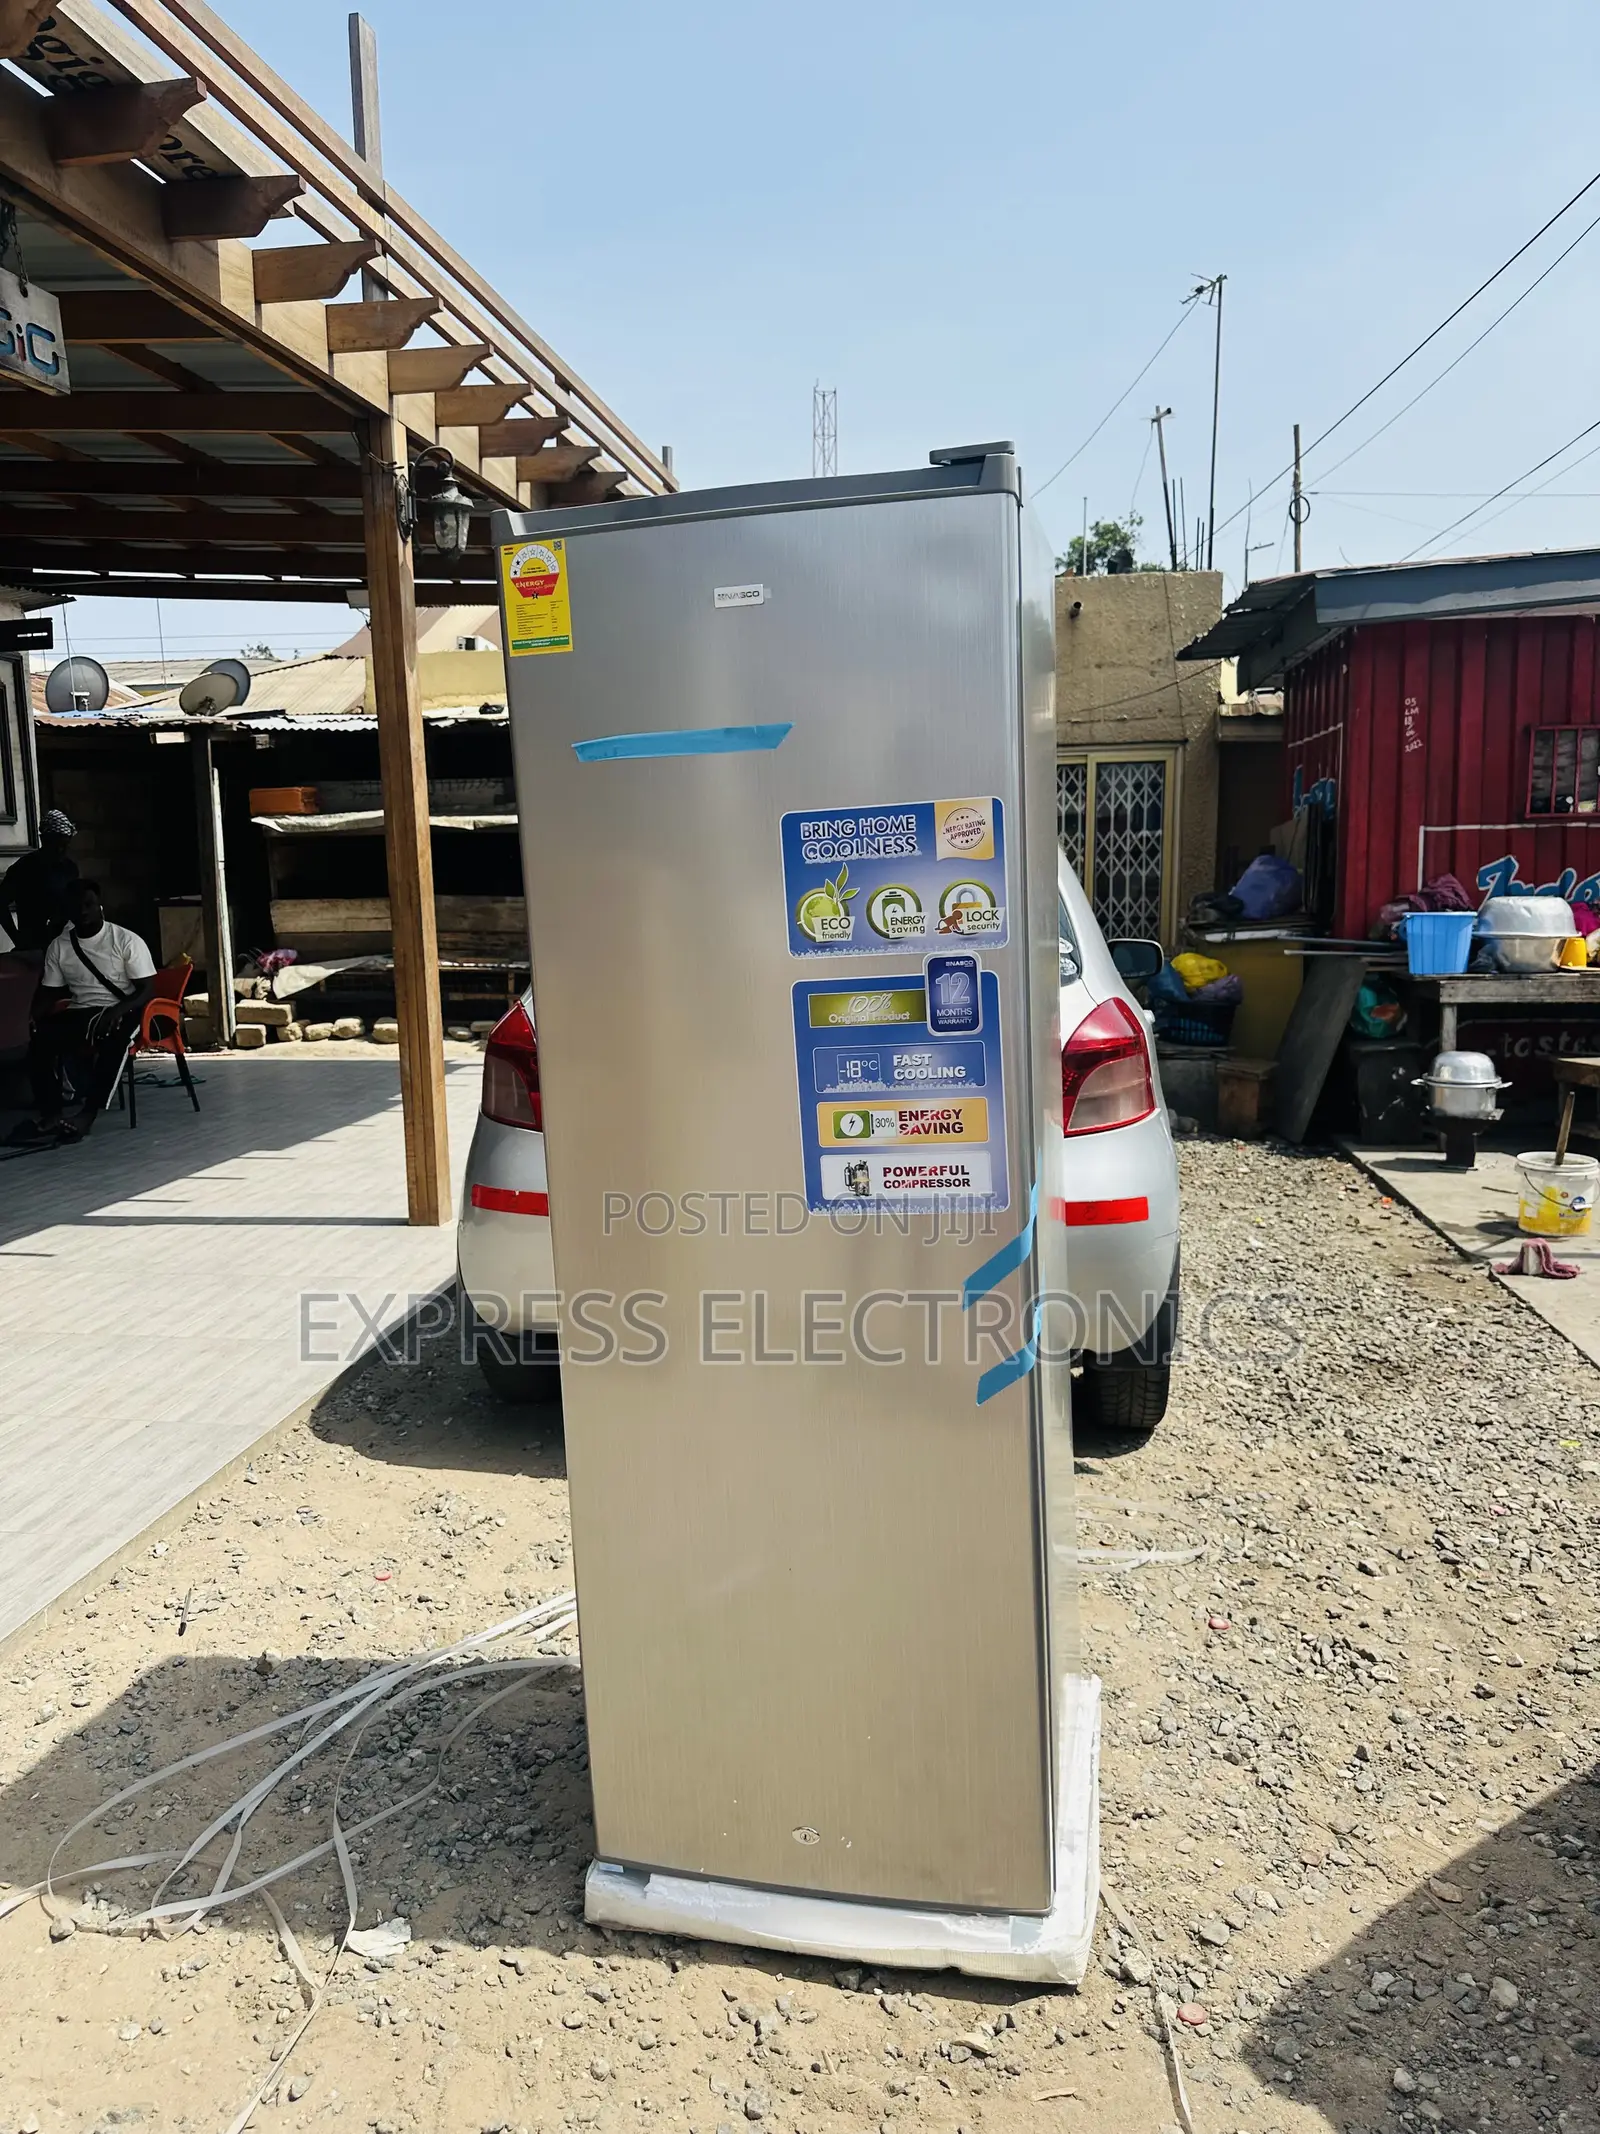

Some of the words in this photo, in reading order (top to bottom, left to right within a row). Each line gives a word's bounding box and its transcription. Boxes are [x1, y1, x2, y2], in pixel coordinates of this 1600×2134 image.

[515, 580, 545, 588] ENERGY
[801, 818, 857, 841] BRING
[859, 814, 917, 836] HOME
[950, 827, 982, 841] APPROVED
[802, 834, 918, 861] COOLNESS
[890, 915, 926, 926] ENERGY
[966, 909, 1000, 922] LOCK
[821, 917, 851, 930] ECO
[891, 924, 926, 935] saving
[967, 921, 1000, 931] security
[822, 930, 852, 940] friendly
[935, 971, 971, 1005] 12
[828, 1012, 870, 1025] Original
[871, 1011, 910, 1022] Product
[937, 1007, 973, 1017] MONTHS
[893, 1053, 932, 1067] FAST
[893, 1065, 967, 1081] COOLING
[899, 1109, 963, 1122] ENERGY
[875, 1117, 895, 1128] 30%
[899, 1122, 964, 1135] SAVING
[883, 1165, 970, 1177] POWERFUL
[883, 1178, 971, 1189] COMPRESSOR
